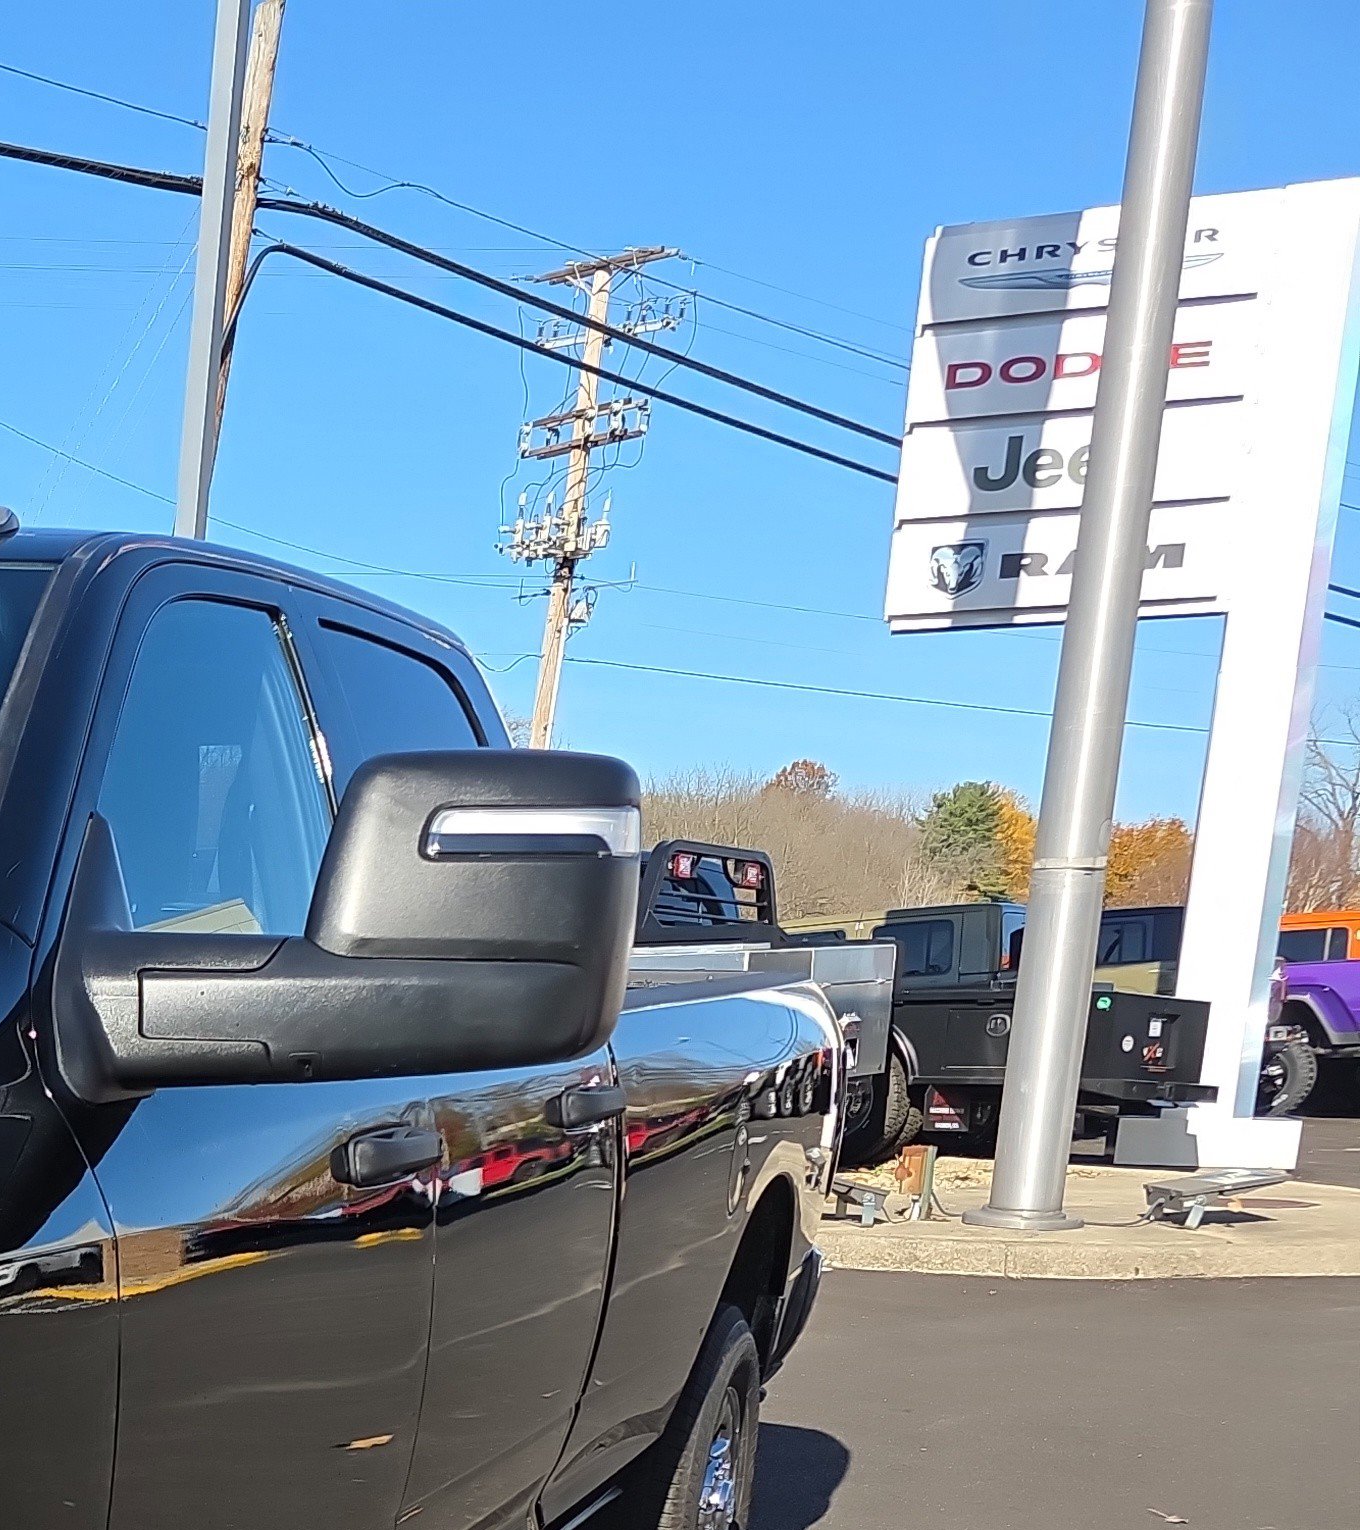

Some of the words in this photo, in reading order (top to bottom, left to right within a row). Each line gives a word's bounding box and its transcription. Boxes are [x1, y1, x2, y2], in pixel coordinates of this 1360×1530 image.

[967, 227, 1220, 267] CHRYSR
[944, 340, 1213, 391] DODE
[972, 435, 1092, 493] Jee
